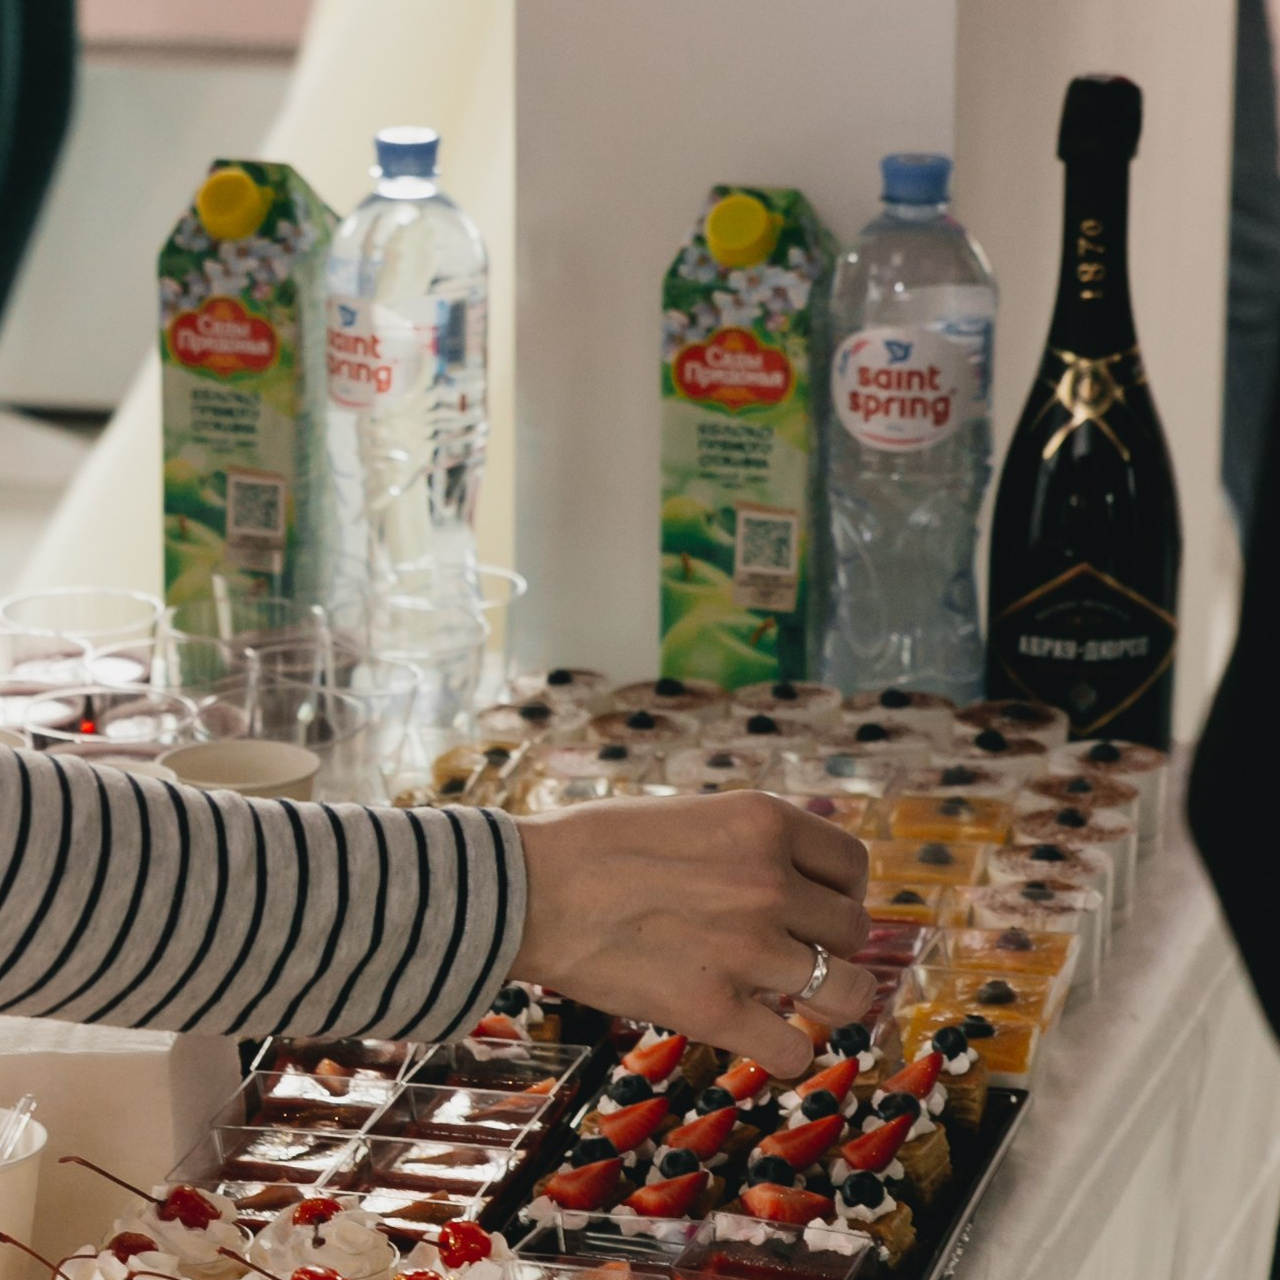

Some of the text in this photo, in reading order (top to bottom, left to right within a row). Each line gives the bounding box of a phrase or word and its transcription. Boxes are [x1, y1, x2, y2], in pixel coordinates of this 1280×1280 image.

[1077, 219, 1106, 300] 1870
[327, 329, 382, 359] aint
[705, 344, 764, 369] Сады
[858, 364, 941, 391] saint
[848, 391, 951, 427] spring
